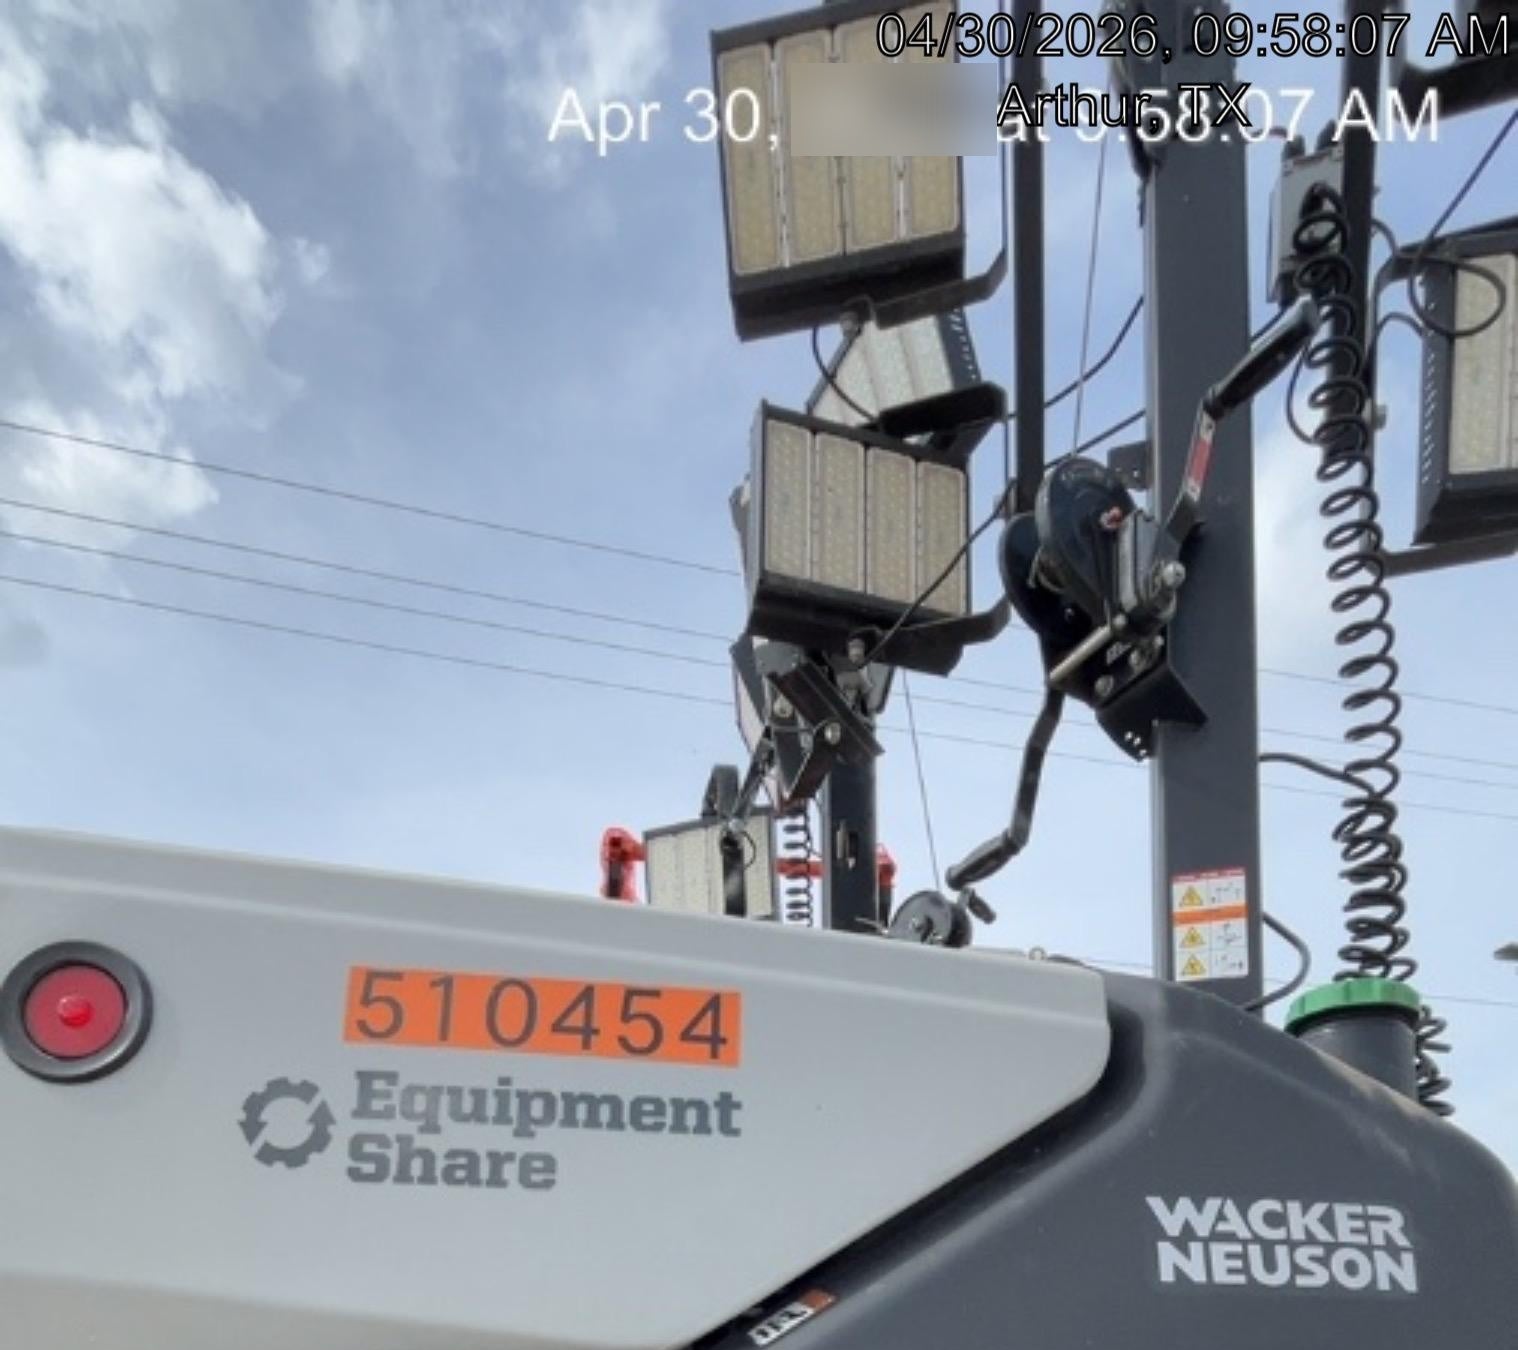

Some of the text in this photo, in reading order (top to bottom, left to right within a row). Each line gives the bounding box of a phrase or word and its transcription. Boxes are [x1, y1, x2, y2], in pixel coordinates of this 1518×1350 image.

[355, 970, 728, 1060] 510454
[350, 1070, 742, 1138] Equipment
[346, 1133, 557, 1190] Share
[1145, 1196, 1414, 1248] WACKER
[1157, 1241, 1419, 1293] NEUSON
